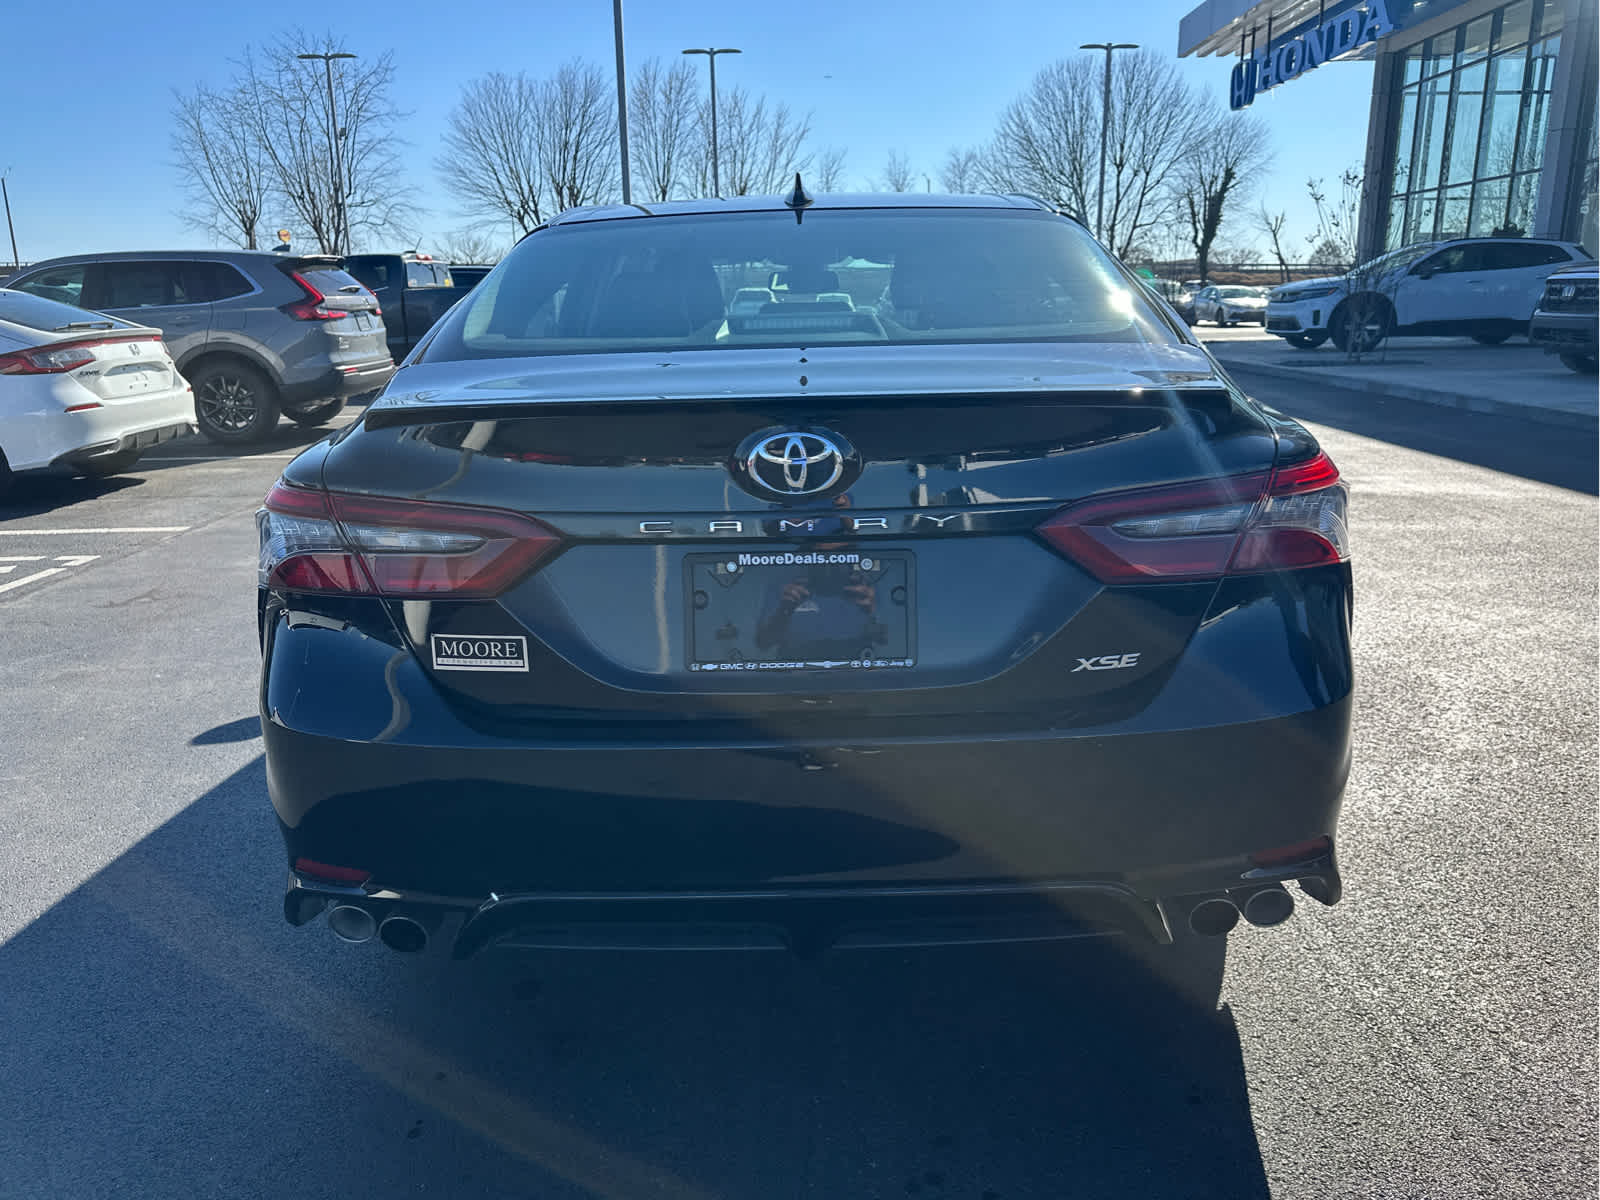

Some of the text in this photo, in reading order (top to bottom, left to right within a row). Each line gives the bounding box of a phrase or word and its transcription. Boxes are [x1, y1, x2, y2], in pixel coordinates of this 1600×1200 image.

[1256, 0, 1393, 93] HONDA
[639, 513, 962, 533] CAMRY
[738, 553, 860, 566] MooreDeals.com
[440, 640, 518, 657] MOORE
[1070, 652, 1141, 673] XSE
